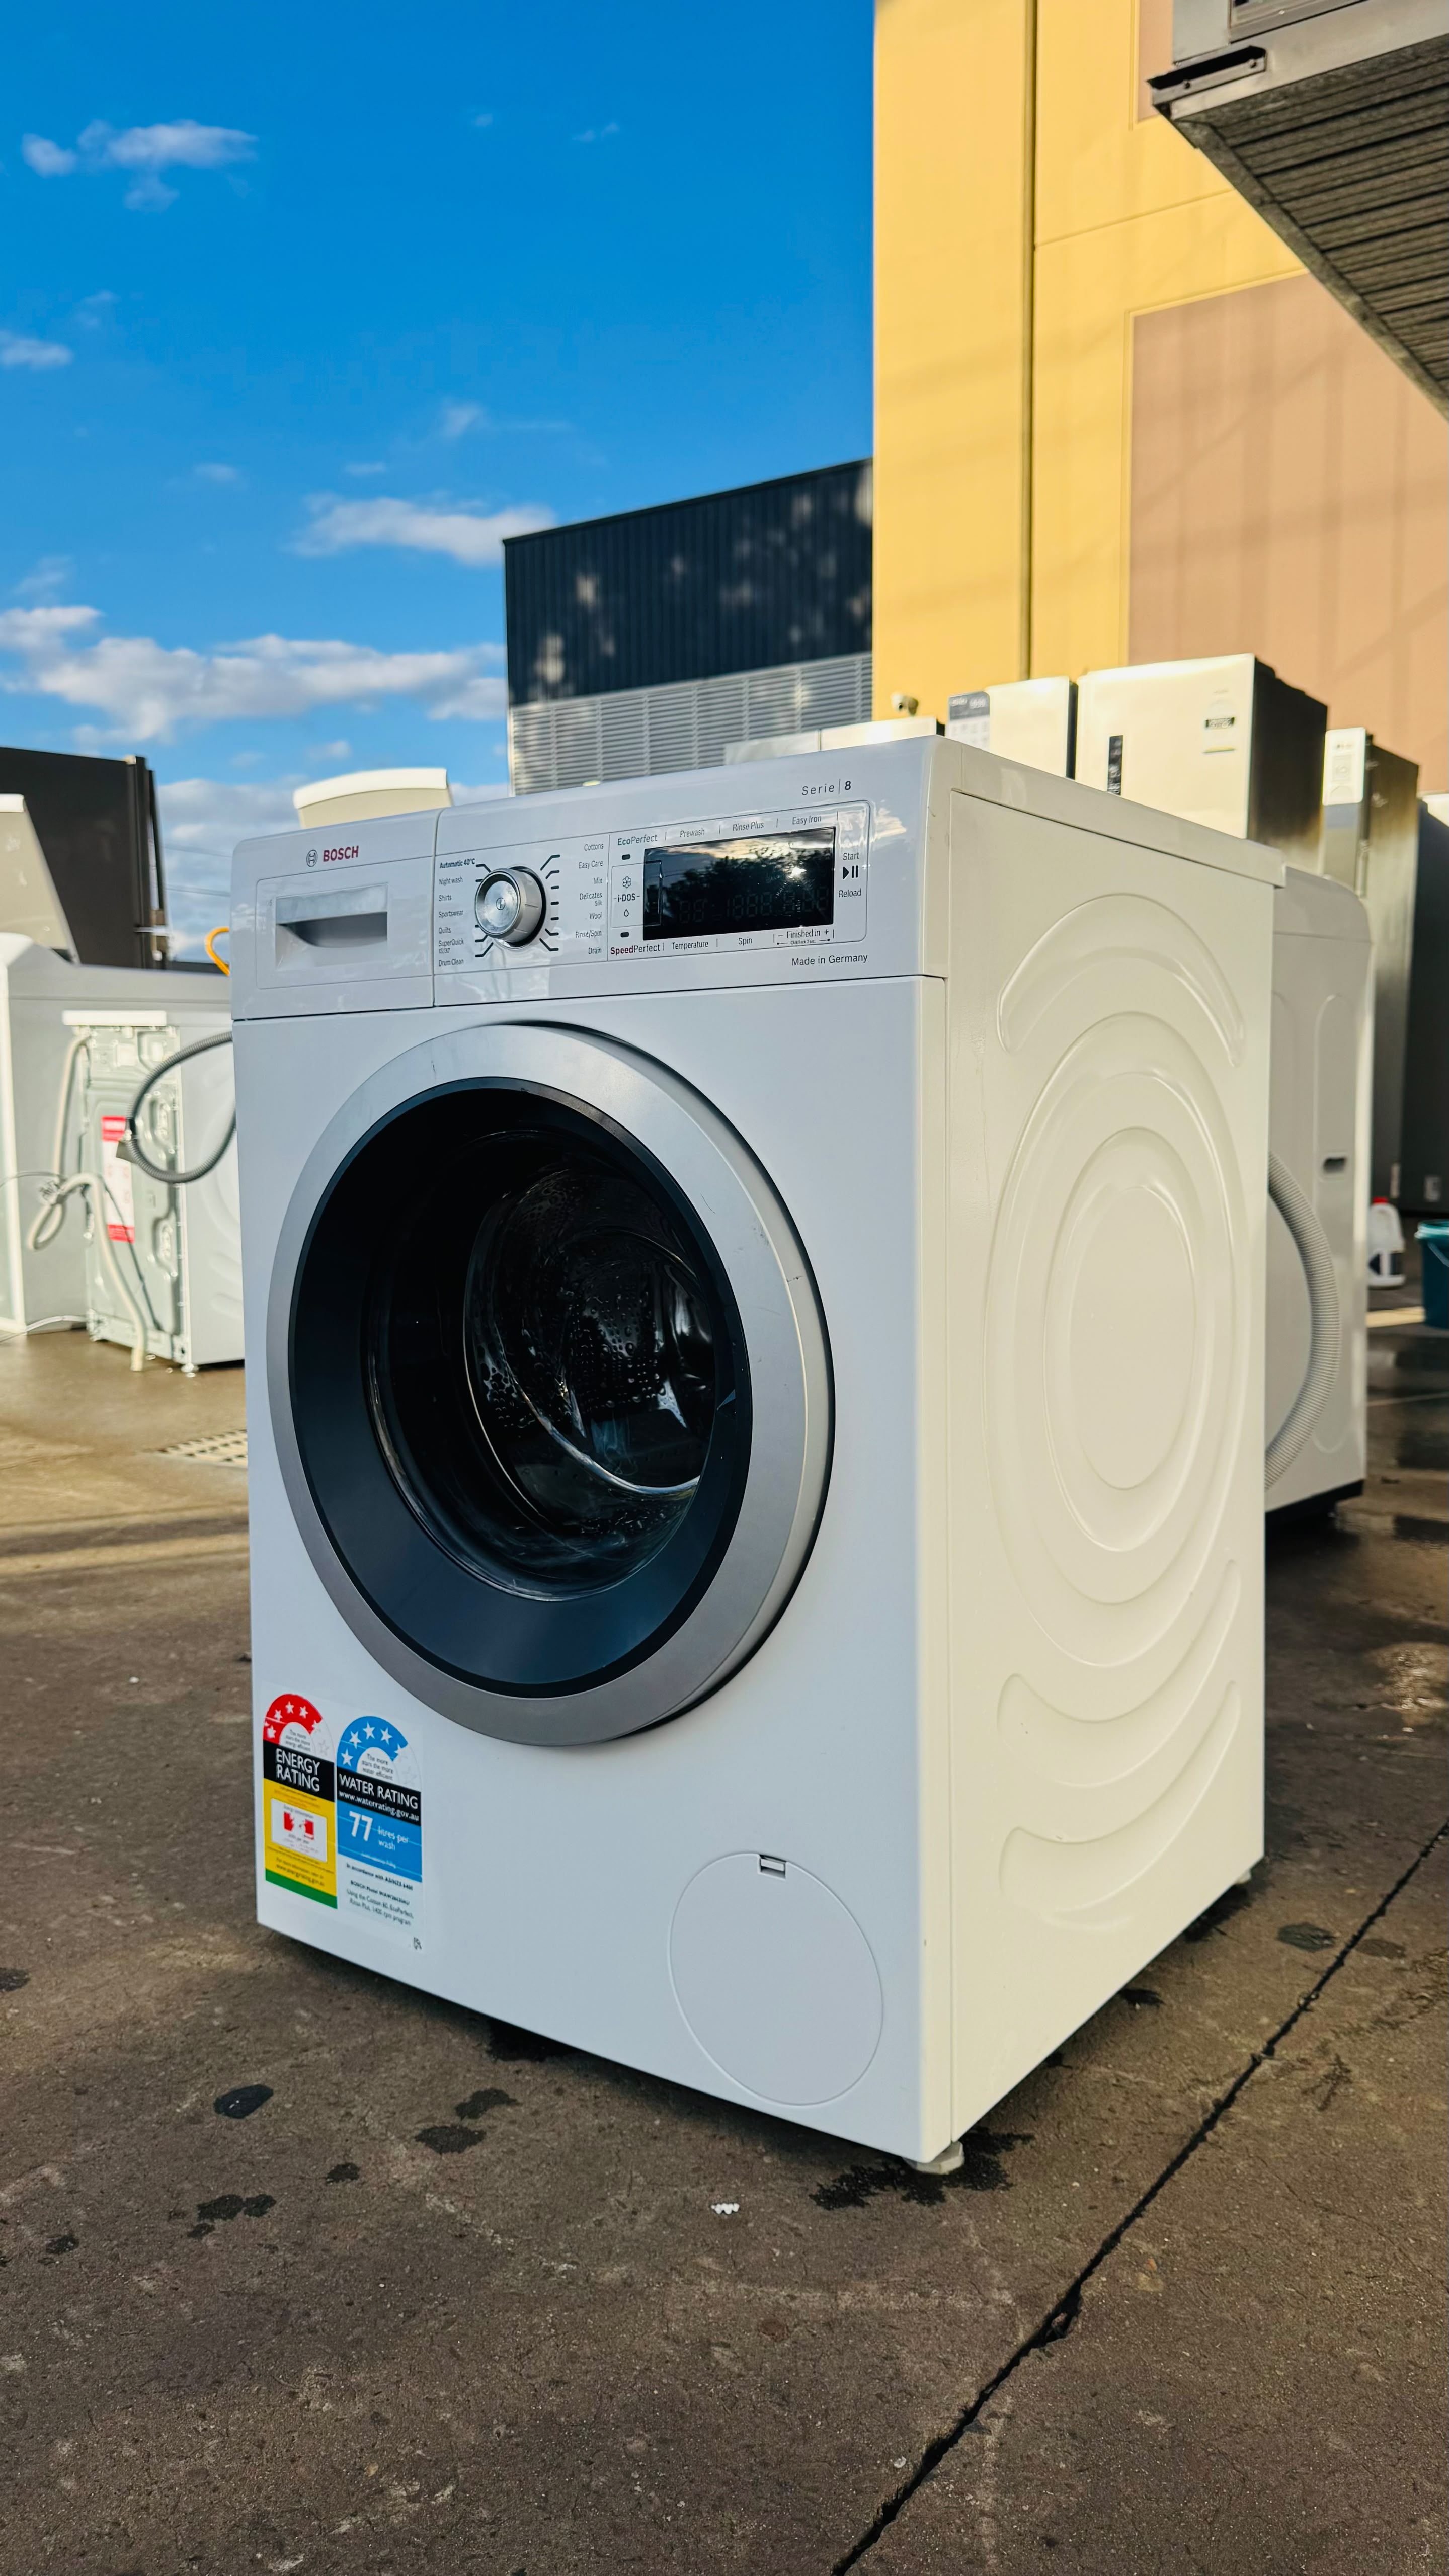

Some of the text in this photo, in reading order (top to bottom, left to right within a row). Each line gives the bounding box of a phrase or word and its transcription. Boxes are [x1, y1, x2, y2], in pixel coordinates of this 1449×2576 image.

[802, 780, 852, 795] Serie 8
[792, 815, 822, 826] Easy Iron
[733, 821, 764, 831] Rinse Plus
[680, 827, 705, 838] Prewash
[617, 834, 658, 846] EcoPerfect
[584, 843, 604, 851] Cottons
[323, 845, 359, 862] BOSCH
[842, 852, 860, 861] Start
[439, 860, 463, 869] Automatic
[579, 892, 603, 900] Delicates
[838, 888, 862, 898] Reload
[589, 911, 603, 919] Wool
[575, 929, 602, 939] Rinse/Spin
[786, 929, 821, 939] Finished in
[672, 940, 709, 950] Temperature
[738, 937, 753, 946] Spin
[588, 946, 602, 955] Drain
[610, 944, 661, 956] SpeedPerfect
[791, 954, 868, 966] Made in Germany
[276, 1748, 321, 1776] ENERGY
[276, 1764, 320, 1792] RATING
[339, 1773, 375, 1797] WATER
[377, 1785, 418, 1810] RATING
[338, 1790, 420, 1822] www.waterrating.gov.au
[349, 1810, 373, 1842] 77
[396, 1834, 409, 1844] per
[378, 1839, 396, 1851] wash
